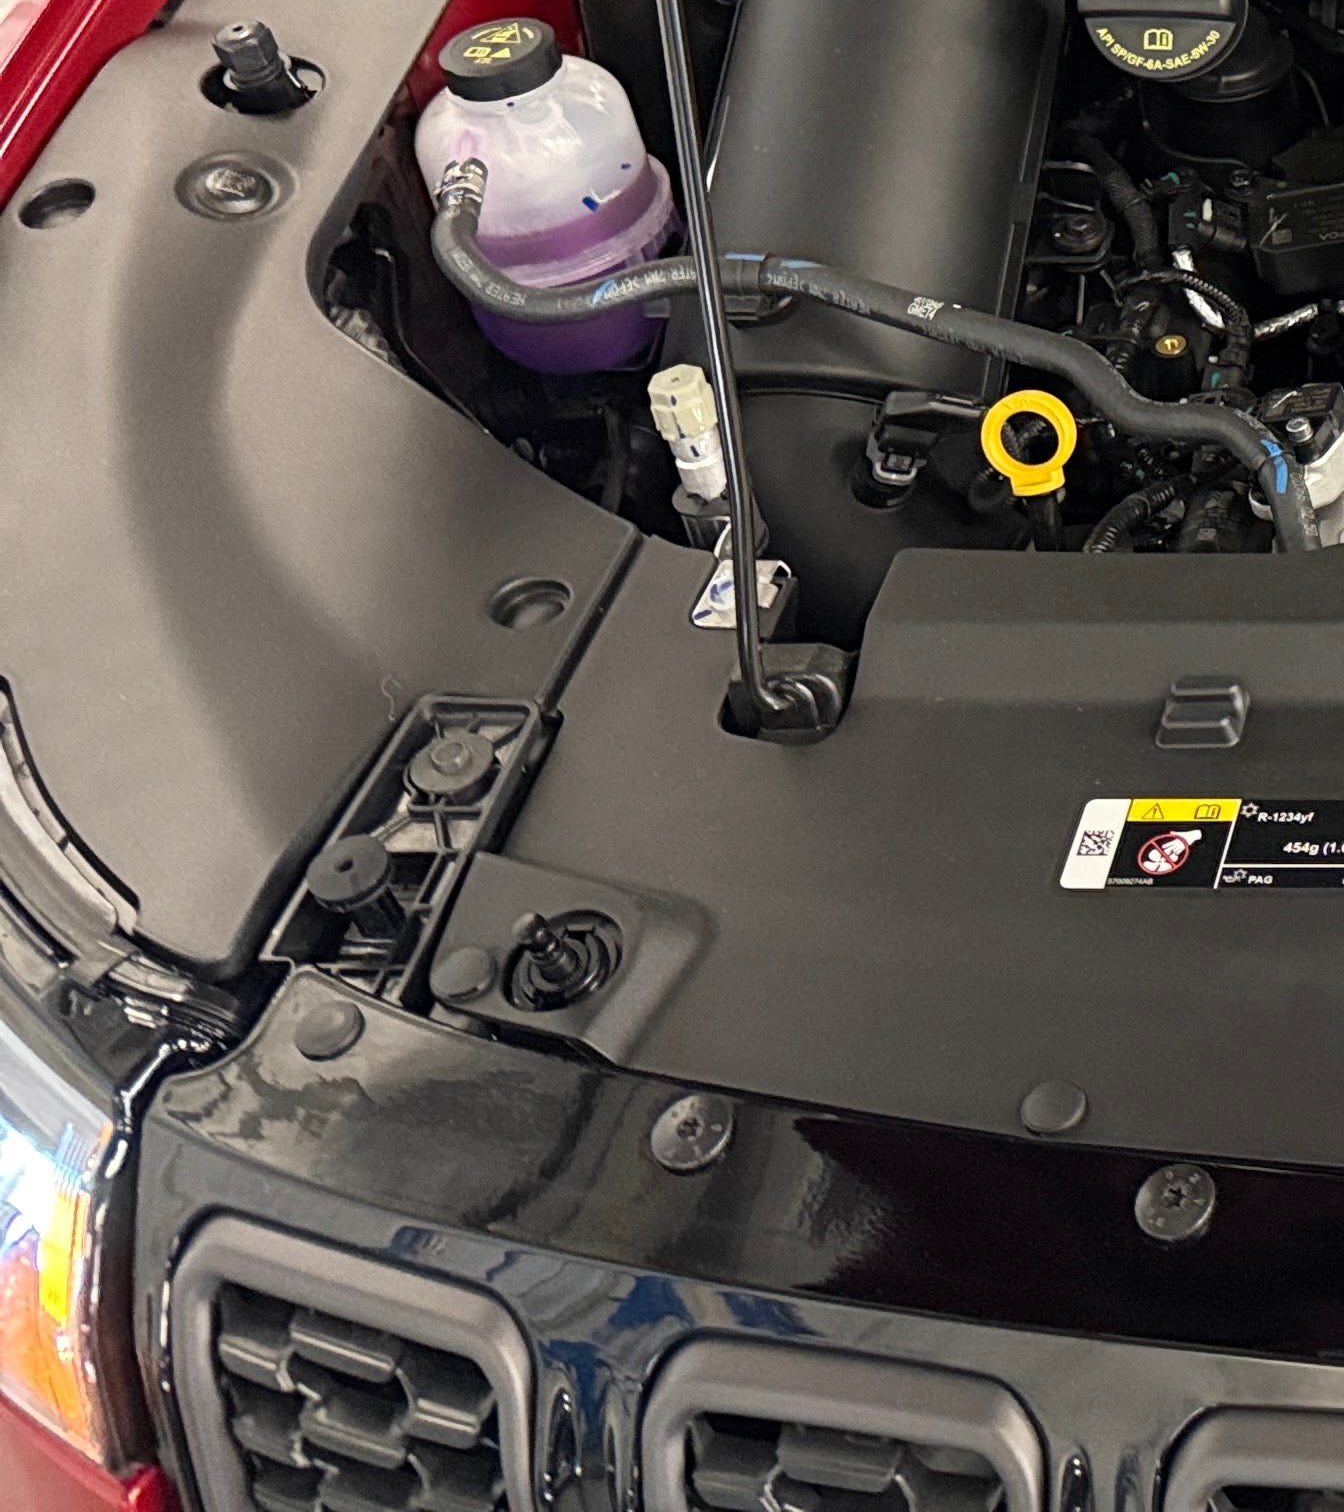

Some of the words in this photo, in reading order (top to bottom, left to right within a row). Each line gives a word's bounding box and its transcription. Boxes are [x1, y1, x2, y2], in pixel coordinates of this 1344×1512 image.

[1096, 27, 1115, 48] API
[1257, 812, 1315, 824] R-1234yf
[1283, 842, 1320, 856] 454g
[1248, 875, 1274, 885] PAG
